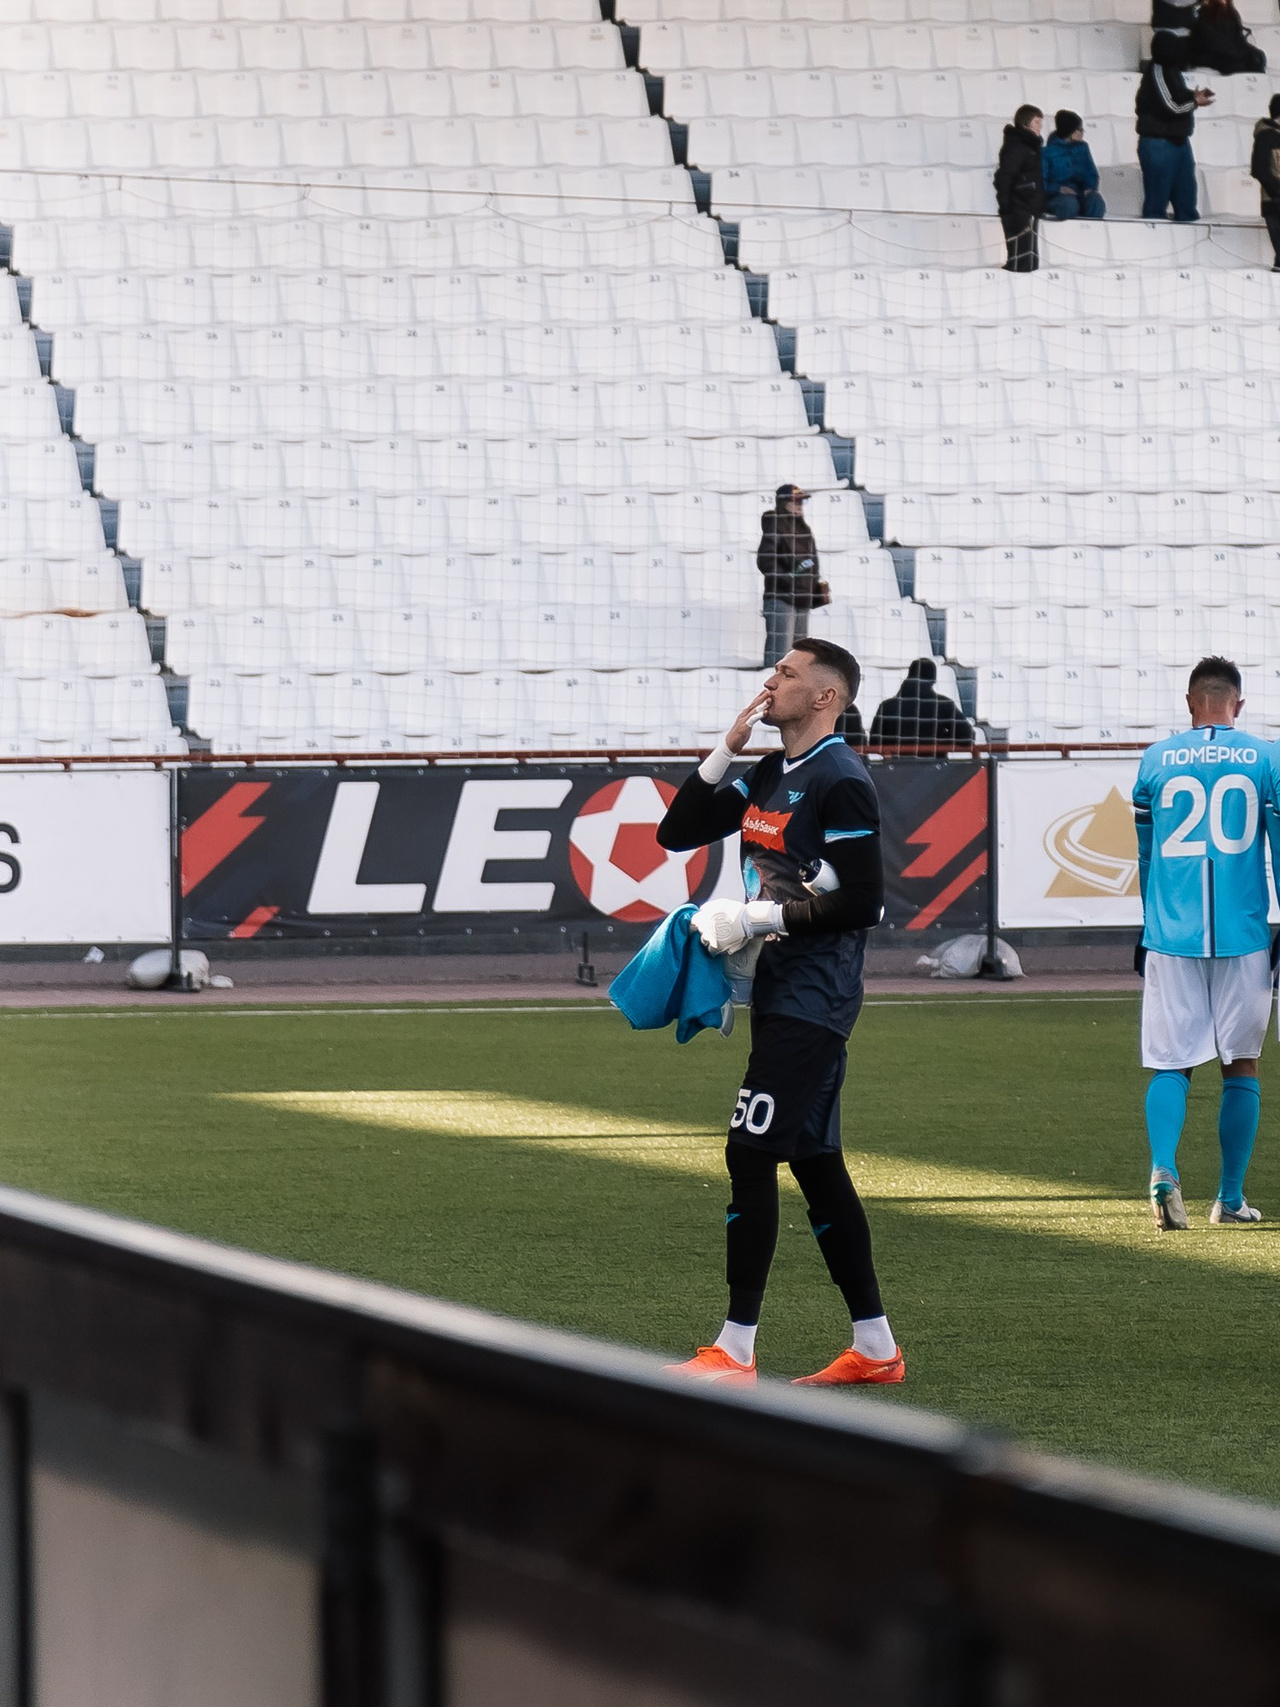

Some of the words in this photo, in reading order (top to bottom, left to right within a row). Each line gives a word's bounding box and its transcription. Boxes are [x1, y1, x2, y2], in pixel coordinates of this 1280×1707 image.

[1162, 746, 1258, 767] ПОМЕРКО
[1160, 773, 1260, 858] 20
[730, 1088, 776, 1135] 50
